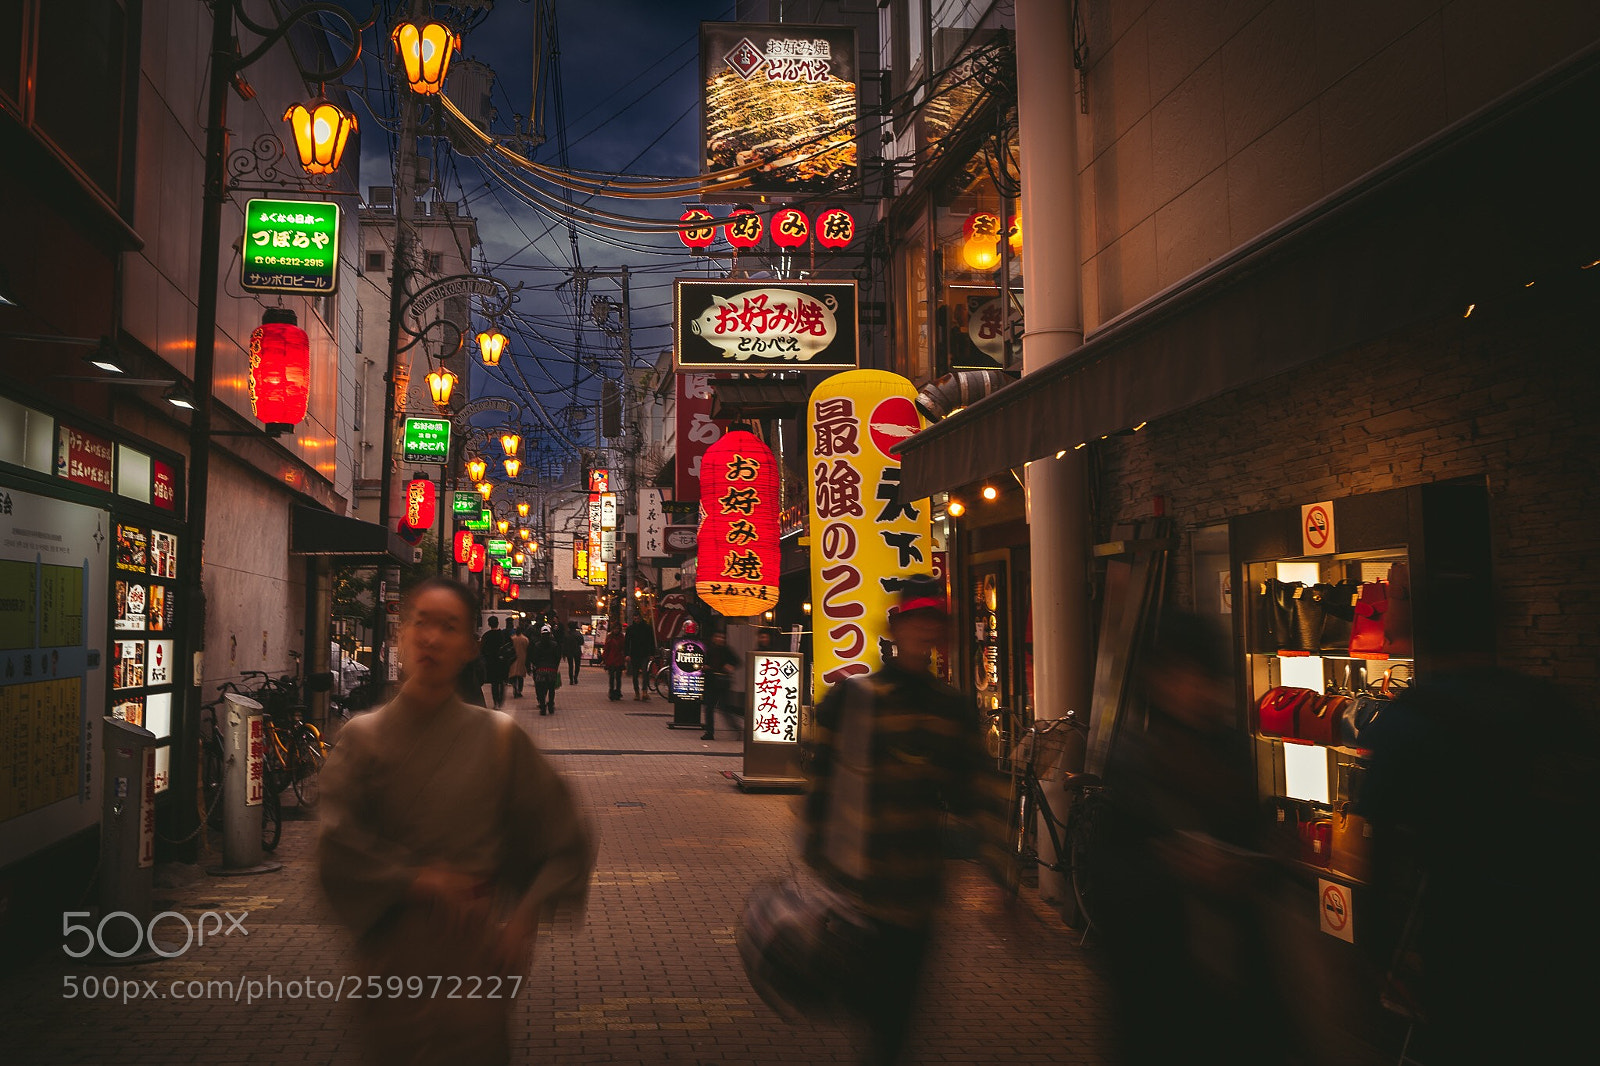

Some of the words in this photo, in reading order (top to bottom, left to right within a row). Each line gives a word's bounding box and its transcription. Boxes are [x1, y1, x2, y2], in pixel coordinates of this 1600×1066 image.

[767, 40, 829, 55] お好み焼
[767, 59, 829, 81] とんべえ
[252, 230, 330, 250] づぼらや
[265, 256, 324, 267] 06-6212-2915
[250, 273, 327, 287] サッポロビール
[714, 294, 827, 336] お好み焼
[738, 337, 801, 352] とんべえ
[719, 455, 763, 580] お好み焼
[710, 584, 769, 600] とんべえ
[676, 652, 704, 664] JUPITER
[755, 658, 782, 735] お好み焼
[783, 687, 798, 741] とんべえ
